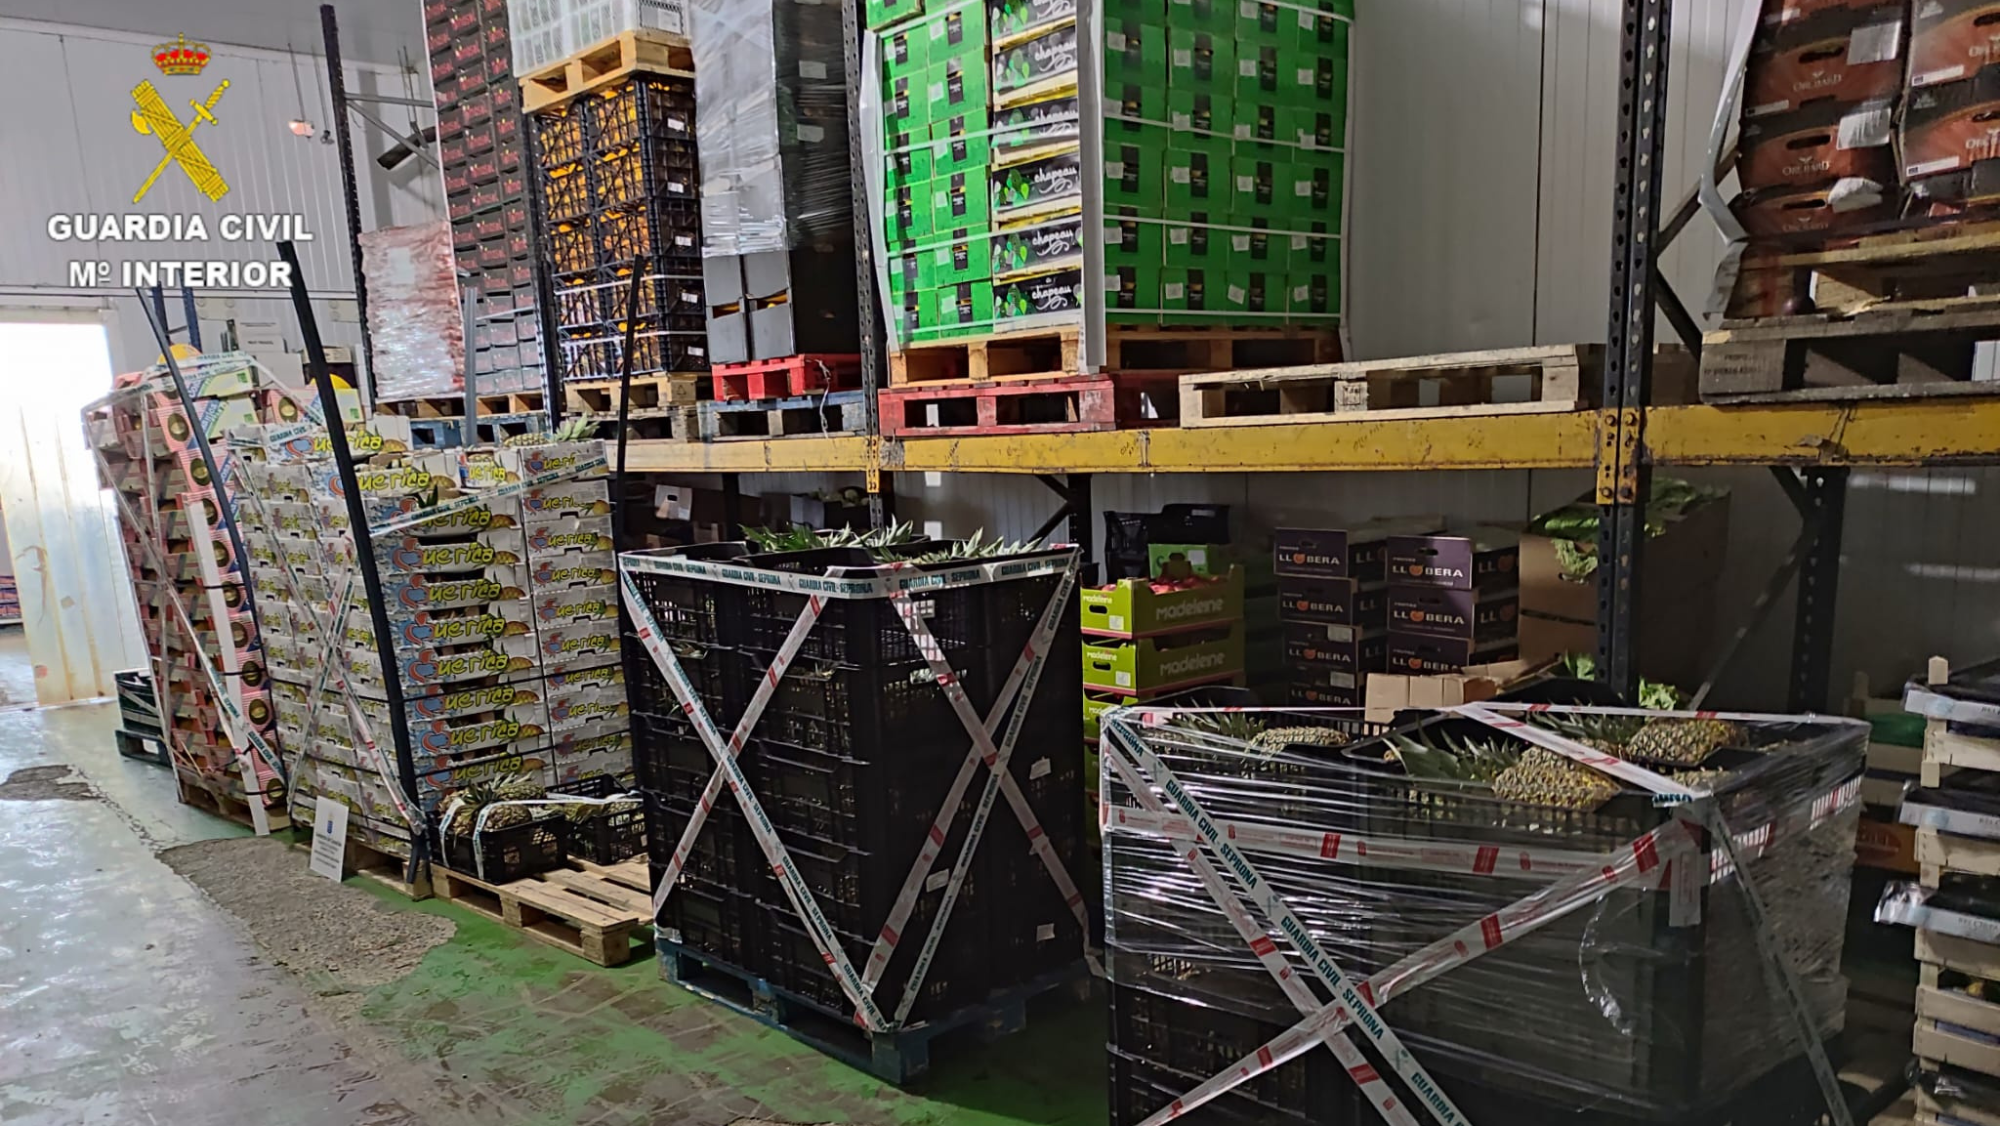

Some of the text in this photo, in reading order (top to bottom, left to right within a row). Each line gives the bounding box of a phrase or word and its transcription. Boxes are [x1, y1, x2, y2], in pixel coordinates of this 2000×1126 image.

[1034, 166, 1078, 188] chapeau
[1032, 228, 1074, 250] chapeau
[1031, 284, 1072, 304] chapeau
[721, 568, 781, 585] GUARDIA CIVIL SEPRONA
[798, 578, 873, 594] GUARDIA CIVIL SEPRONA
[900, 575, 929, 590] GUARDIA
[726, 755, 772, 836] GUARDIA CIVIL SEPRONA
[1165, 778, 1258, 890] GUARDIA CIVIL SEPRONA
[782, 856, 832, 942] GUARDIA CIVIL SEPRONA
[843, 963, 864, 998] GUARDIA
[1280, 915, 1384, 1041] GUARDIA CIVIL SEPRONA
[1411, 1071, 1455, 1124] GUARDIA
